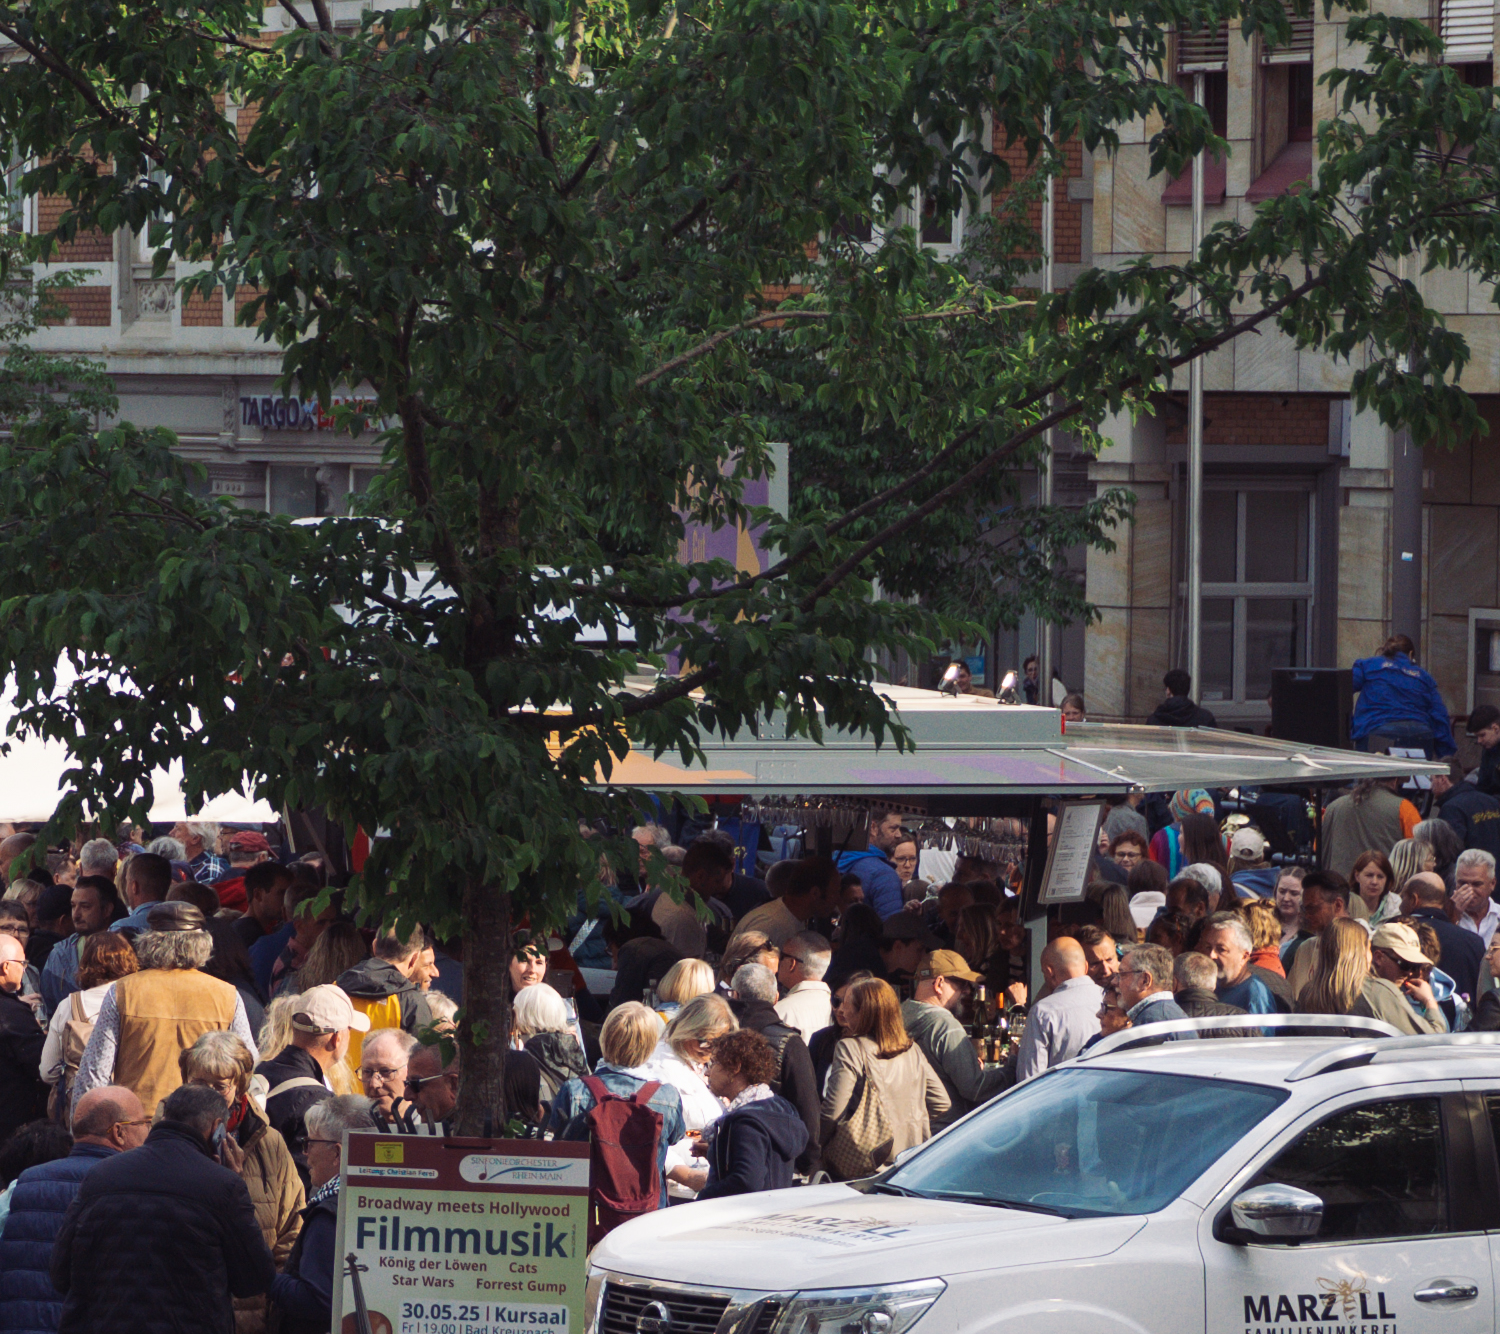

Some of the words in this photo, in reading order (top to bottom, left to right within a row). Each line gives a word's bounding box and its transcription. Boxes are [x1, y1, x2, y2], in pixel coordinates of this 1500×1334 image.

[471, 1156, 558, 1168] SINFONIEORCHESTER
[357, 1195, 433, 1214] Broadway
[437, 1199, 485, 1214] meets
[489, 1201, 570, 1218] Hollywood
[356, 1215, 569, 1258] Filmmusik
[379, 1256, 416, 1271] König
[419, 1257, 441, 1270] der
[445, 1259, 487, 1272] Löwen
[508, 1262, 538, 1274] Cats
[392, 1275, 418, 1287] Star
[422, 1276, 455, 1288] Wars
[476, 1278, 523, 1291] Forrest
[527, 1280, 567, 1296] Gump
[402, 1302, 480, 1322] 30.05.25
[495, 1306, 567, 1325] Kursaal
[402, 1322, 415, 1333] Fr
[423, 1322, 456, 1334] 19.00
